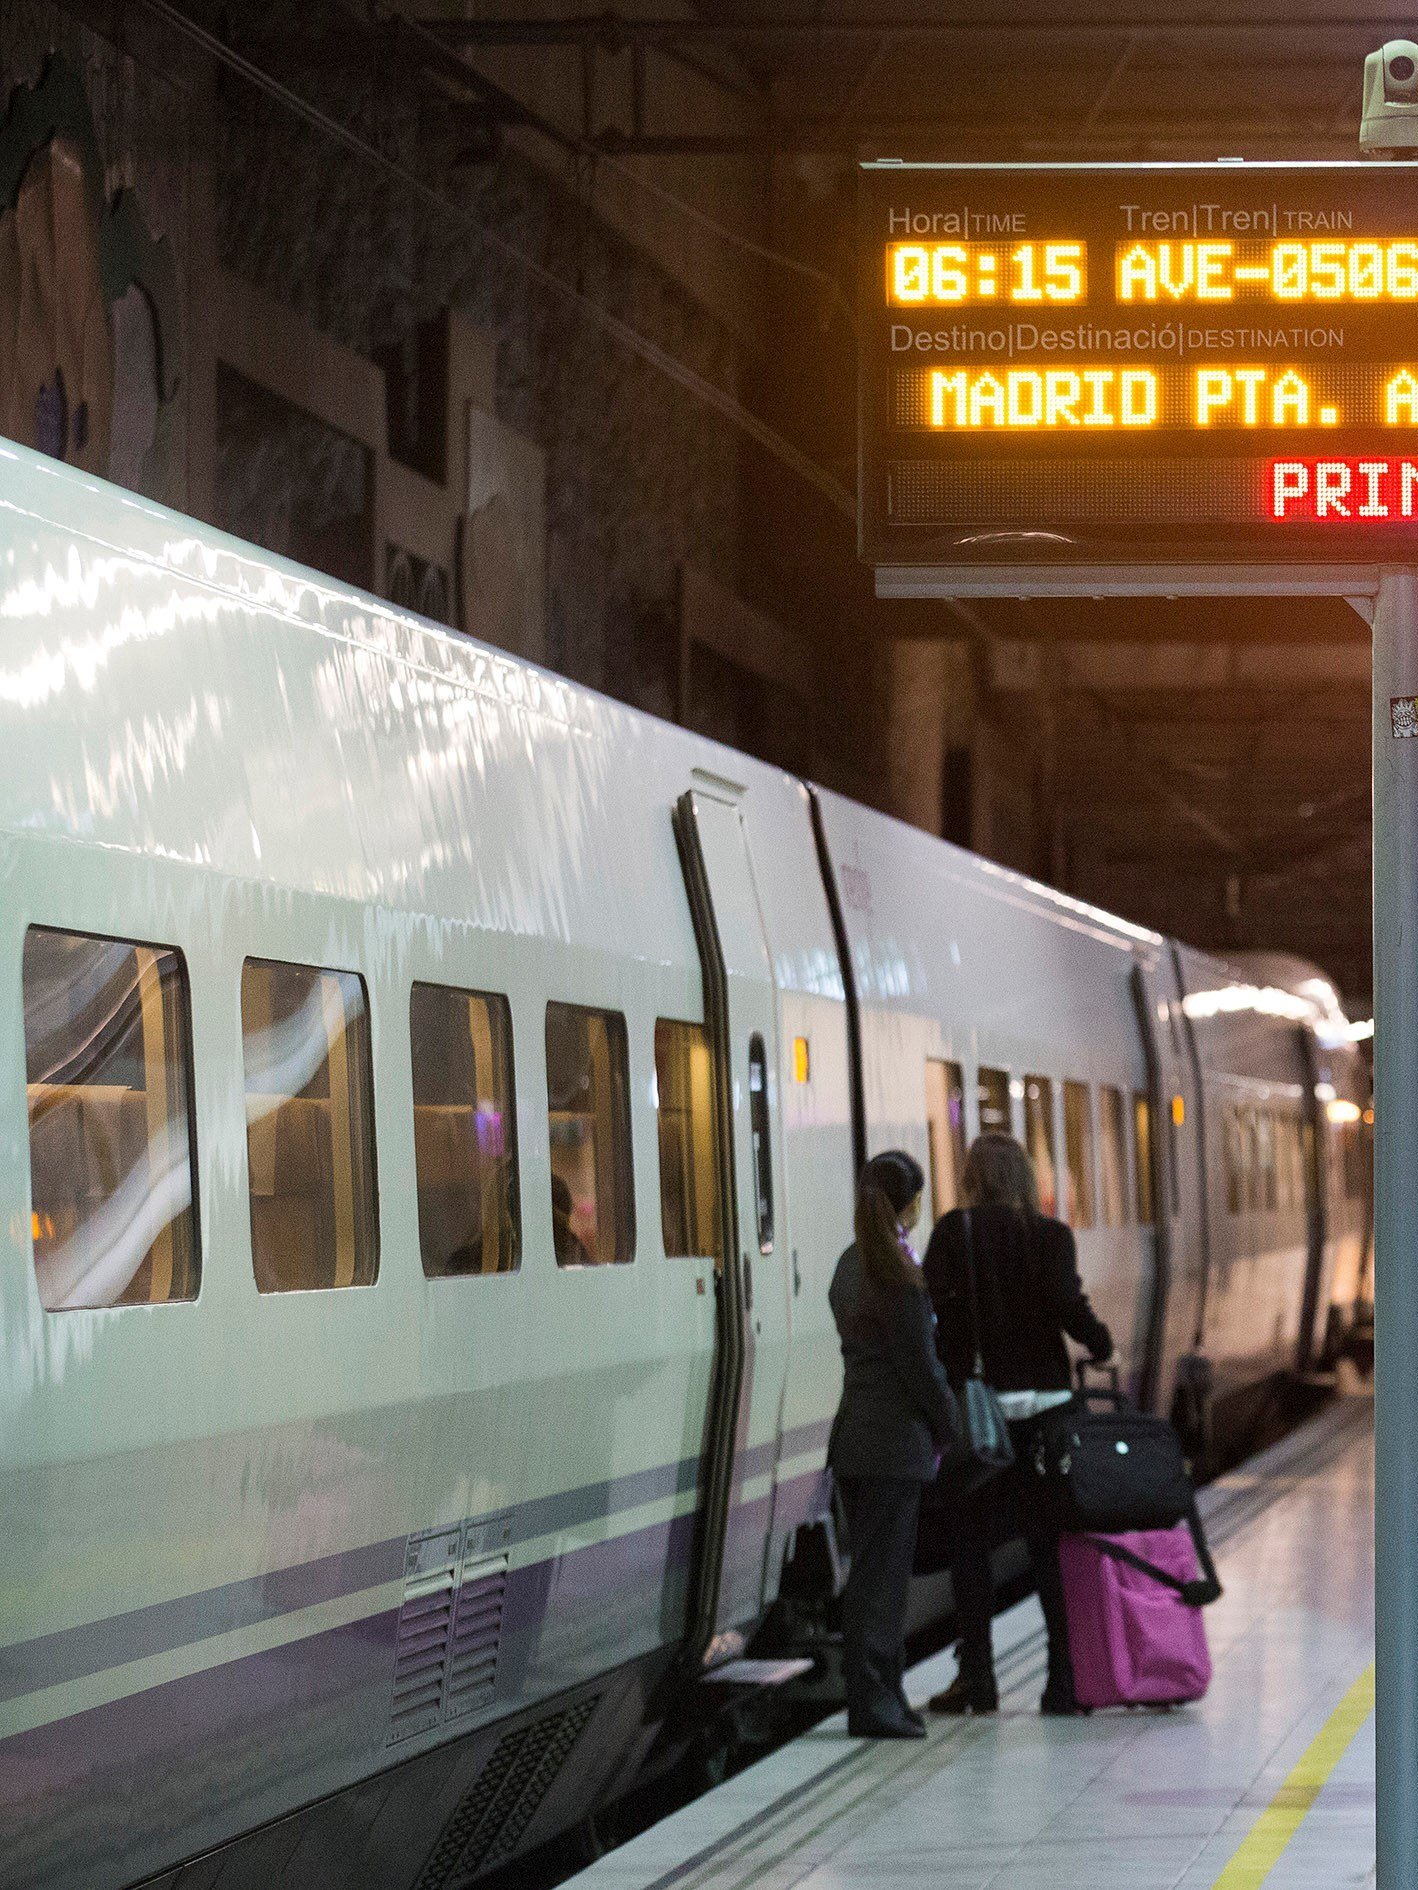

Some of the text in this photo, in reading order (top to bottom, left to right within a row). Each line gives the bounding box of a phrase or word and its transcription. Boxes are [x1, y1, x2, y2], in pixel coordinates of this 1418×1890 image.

[893, 245, 1081, 301] 06:15
[931, 370, 1157, 426] MADRID
[1196, 369, 1338, 425] PTA.
